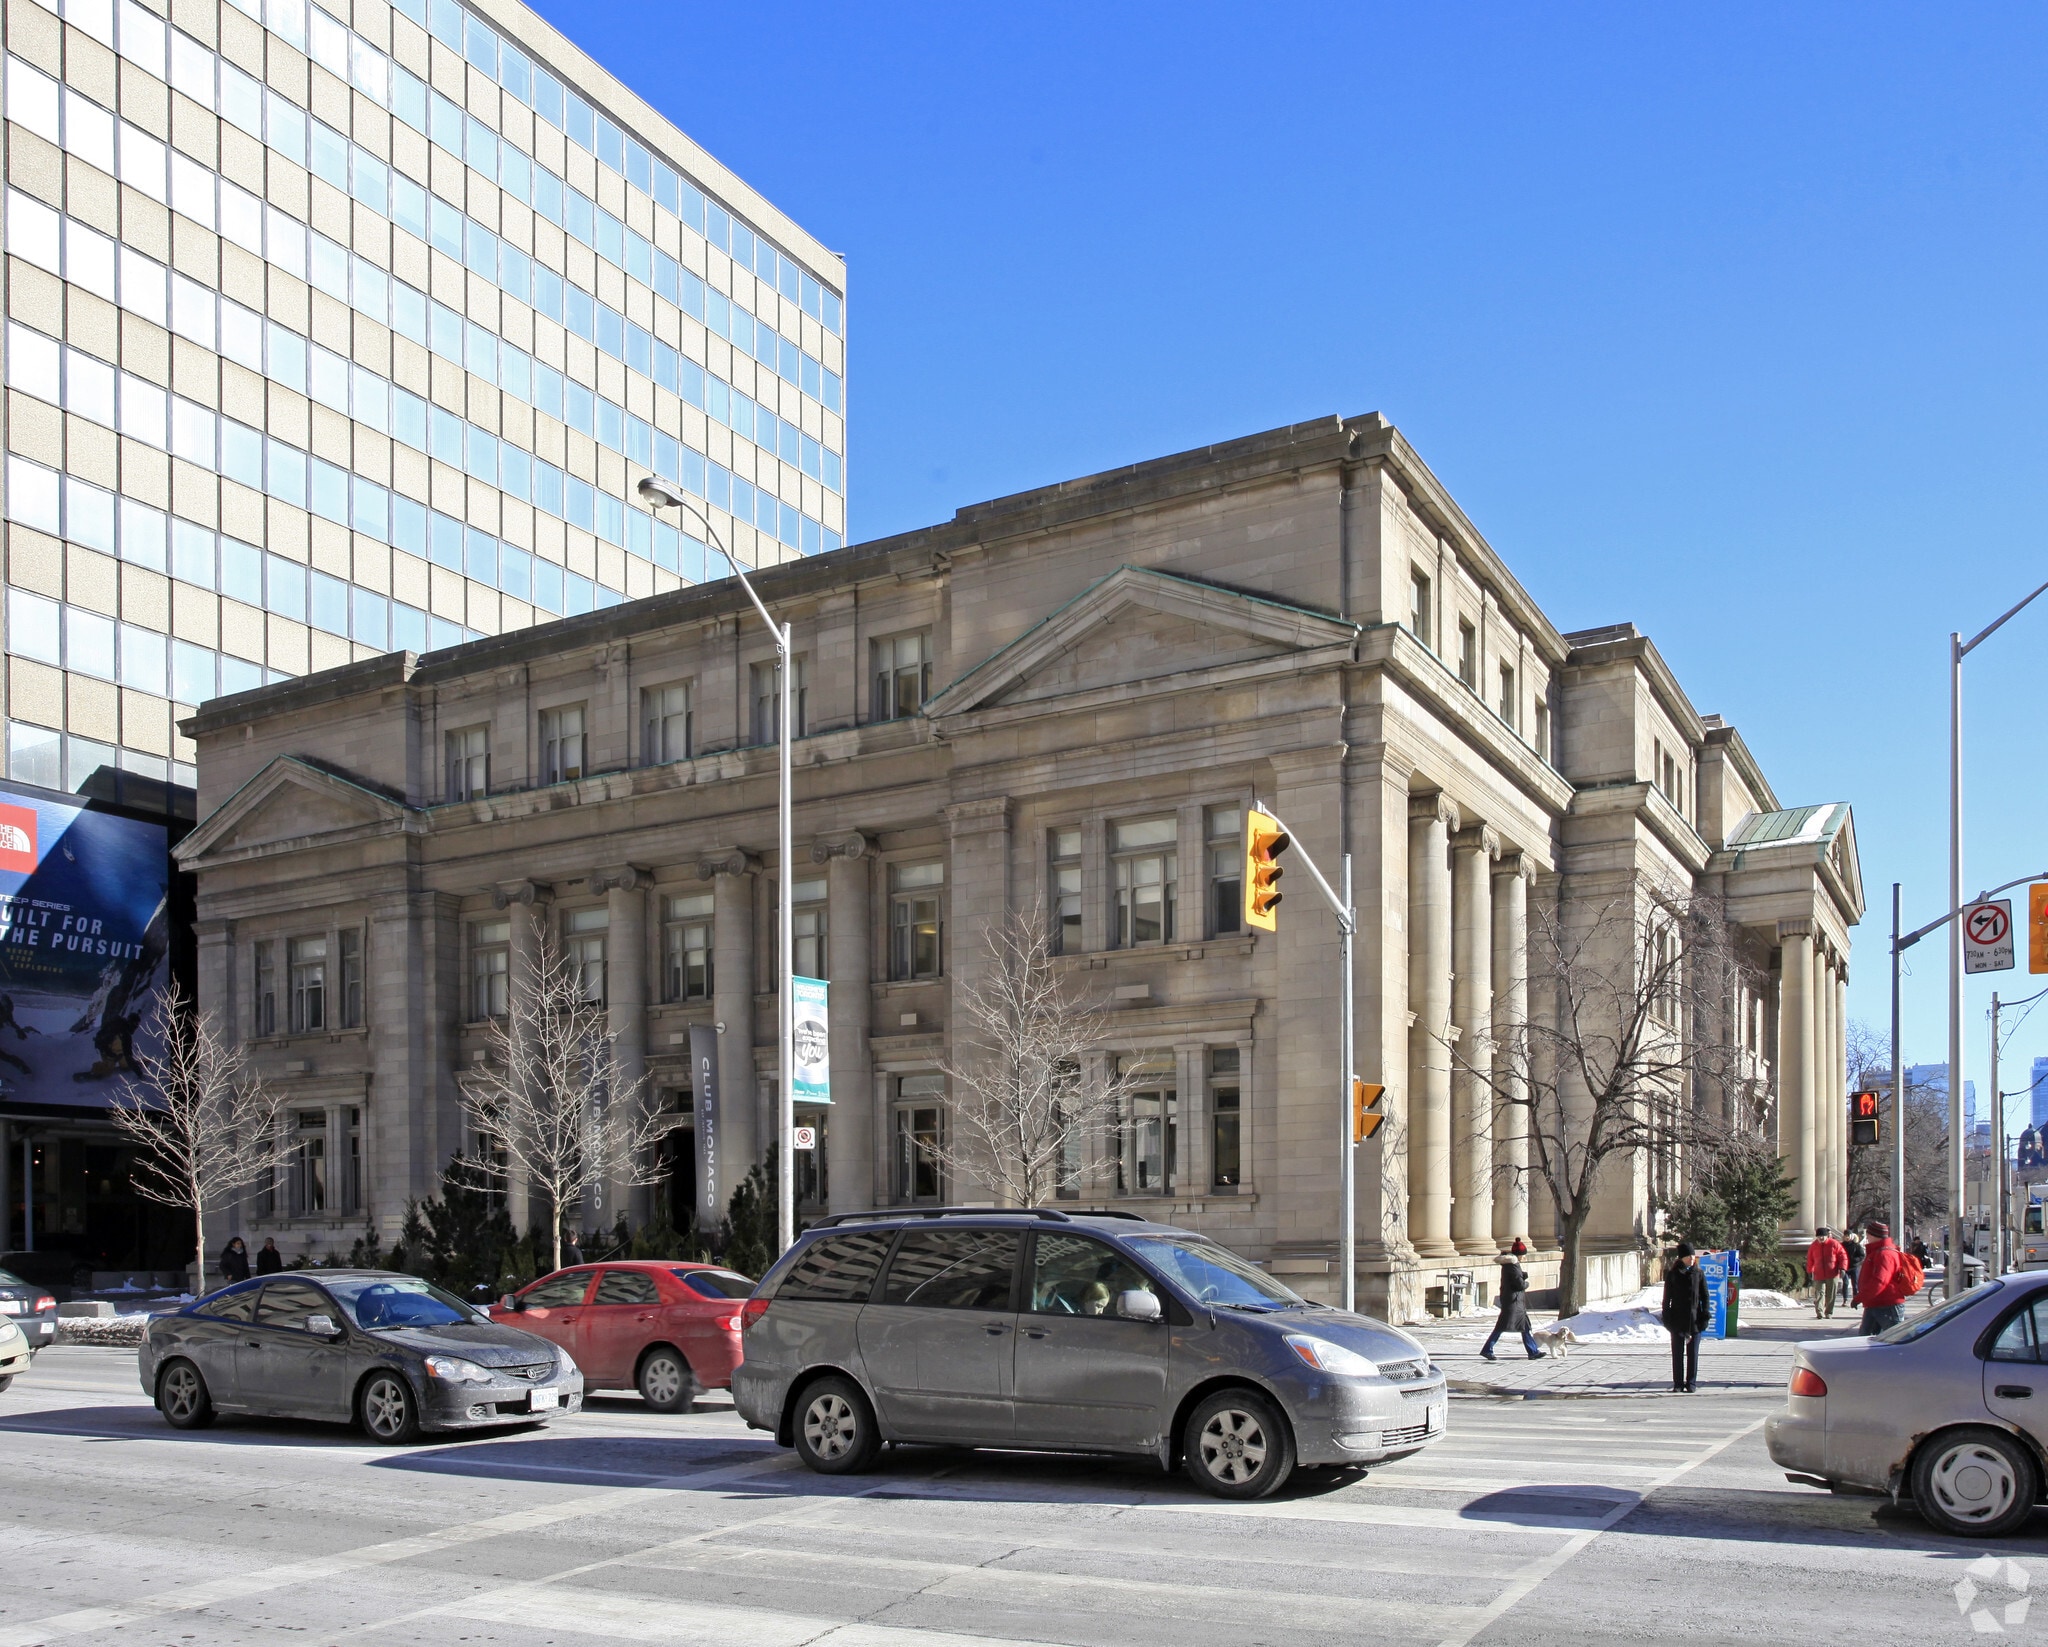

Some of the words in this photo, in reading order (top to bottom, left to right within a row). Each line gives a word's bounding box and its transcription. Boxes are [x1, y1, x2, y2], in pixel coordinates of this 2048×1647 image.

[32, 900, 71, 912] SERIES
[62, 914, 103, 936] FOR
[0, 925, 39, 946] THE
[51, 932, 144, 960] PURSUIT
[796, 989, 825, 1000] TORONTO
[802, 1042, 823, 1063] you
[702, 1056, 713, 1111] CLUB
[706, 1119, 715, 1208] MONACO
